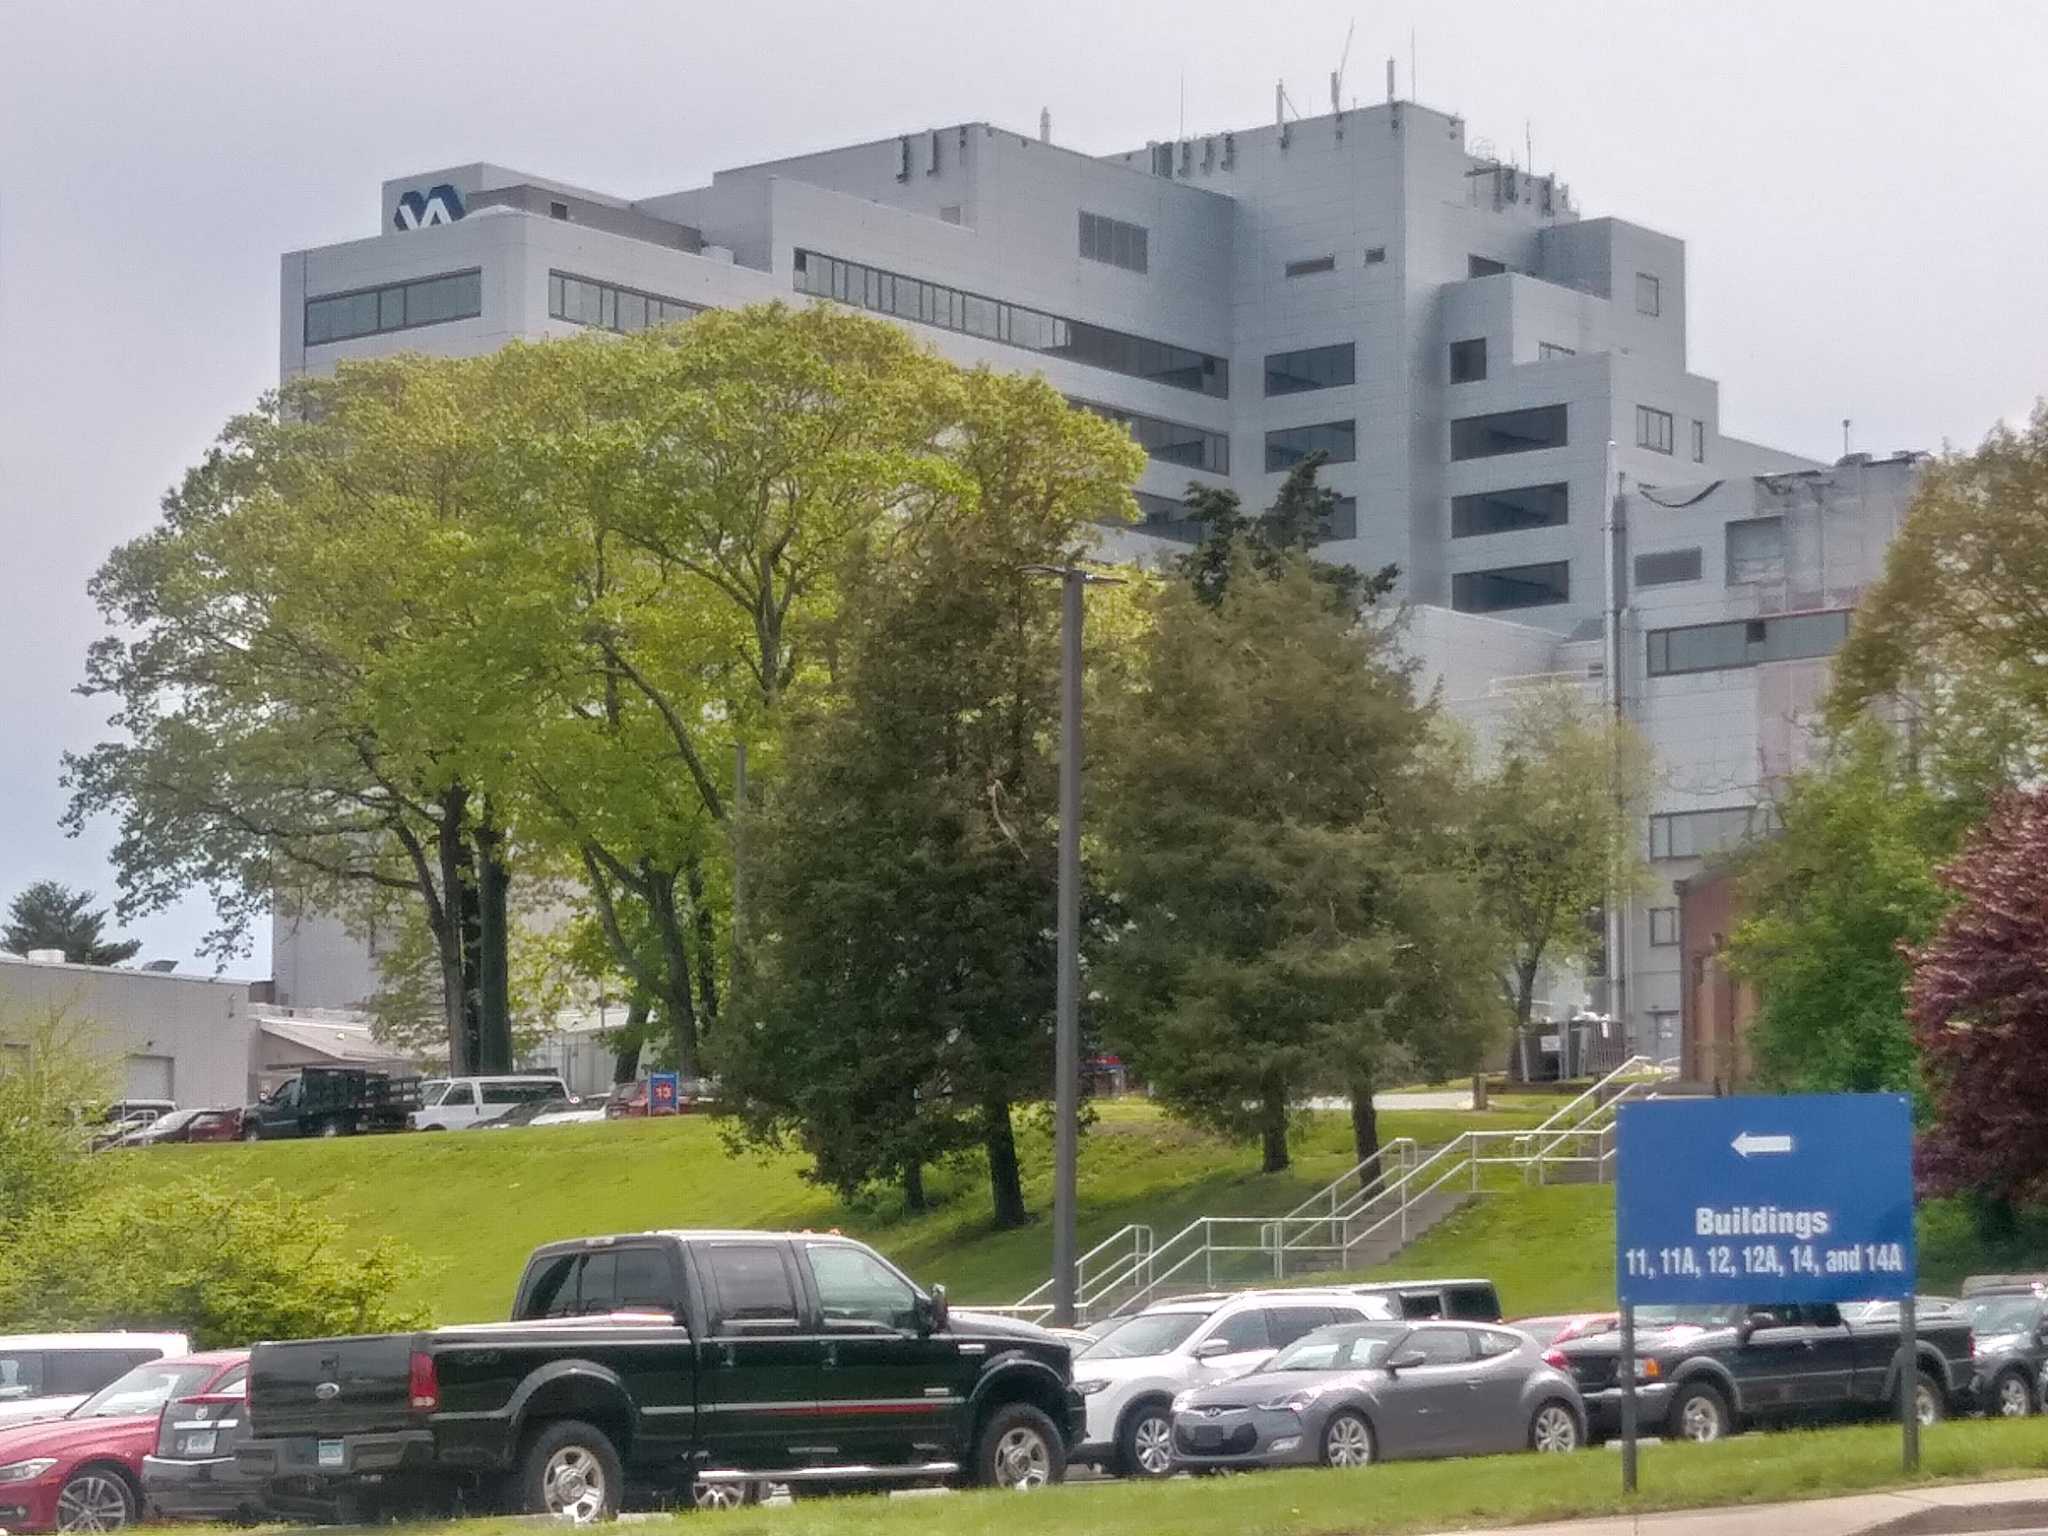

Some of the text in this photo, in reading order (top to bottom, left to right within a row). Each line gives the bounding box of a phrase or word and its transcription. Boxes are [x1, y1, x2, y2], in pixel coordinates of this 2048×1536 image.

[1695, 1206, 1830, 1240] Buildings
[1626, 1243, 1902, 1279] 11, 11A, 12, 12A, 14, and 14A
